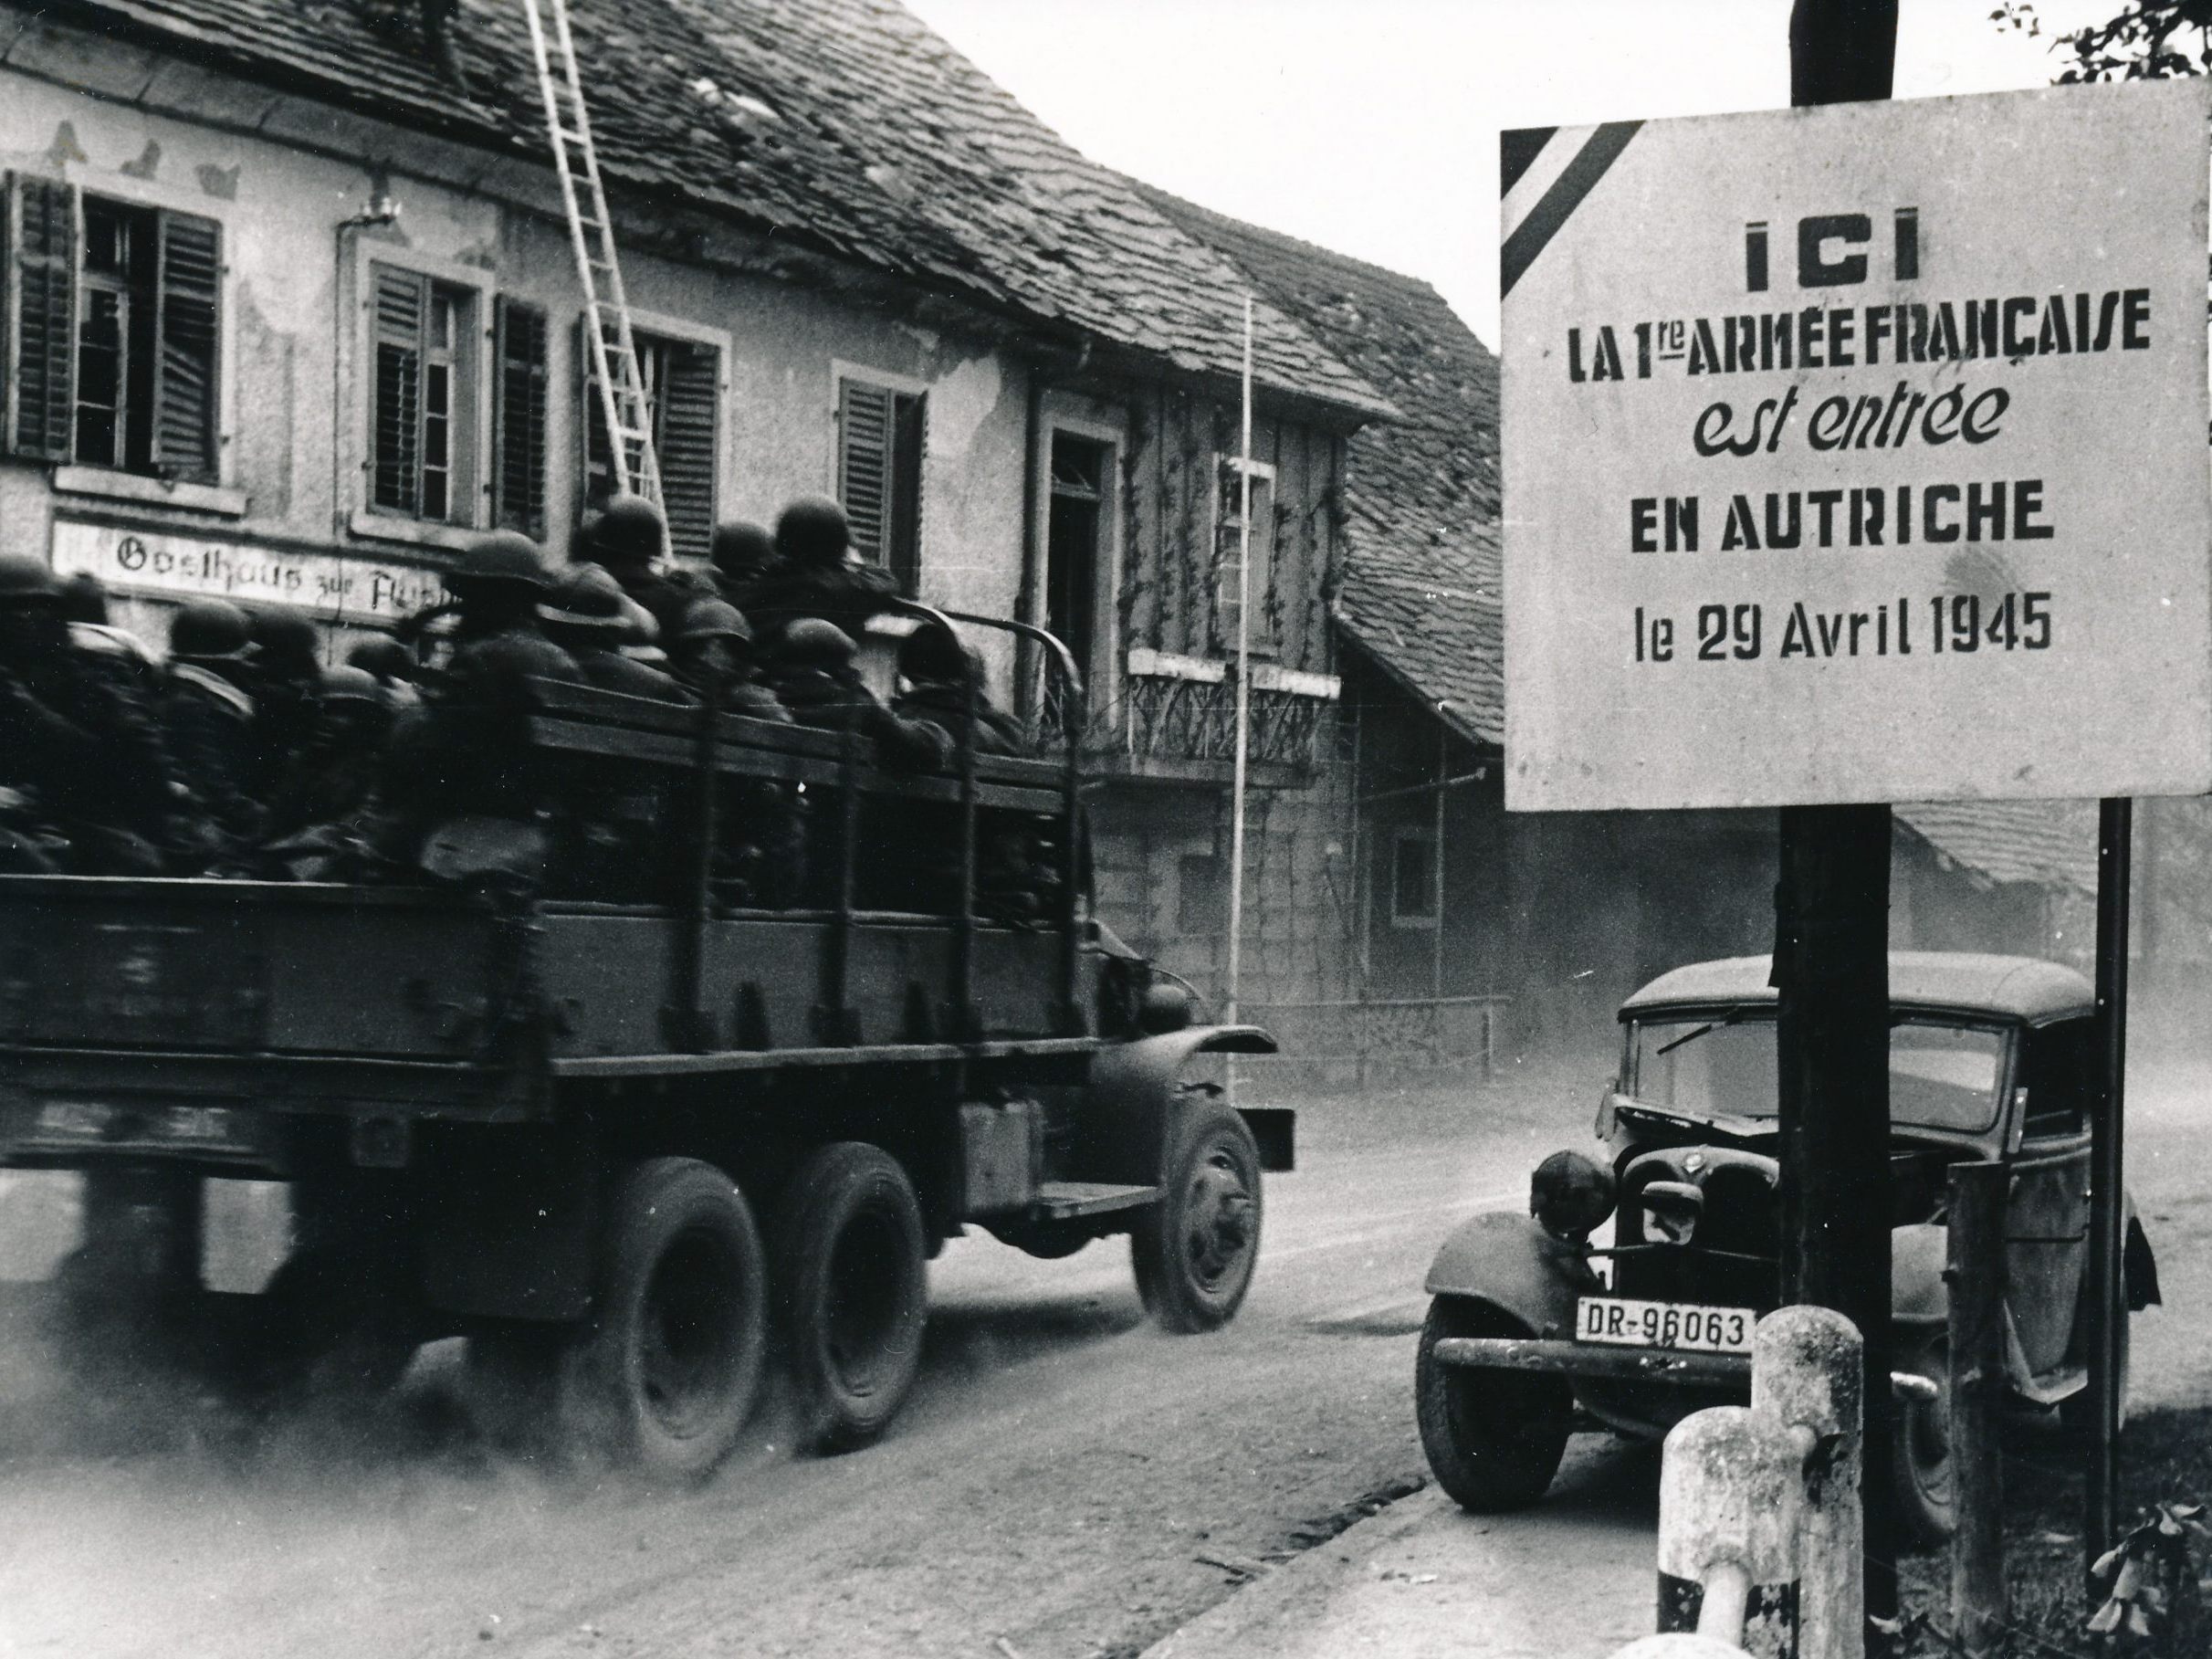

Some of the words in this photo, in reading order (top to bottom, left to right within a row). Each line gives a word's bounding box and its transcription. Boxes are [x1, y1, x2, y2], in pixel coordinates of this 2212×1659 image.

[1746, 205, 1918, 291] ICI
[1568, 326, 1623, 383] LA
[1693, 385, 1798, 457] est
[1808, 381, 2010, 451] entrée
[1631, 497, 1698, 552] EN
[1722, 479, 2055, 551] AUTRICHE
[1635, 606, 1673, 661] le
[1698, 604, 1762, 660] 29
[1780, 598, 1911, 657] Avril
[1930, 592, 2051, 653] 1945
[1588, 1304, 1744, 1346] DR-96063
